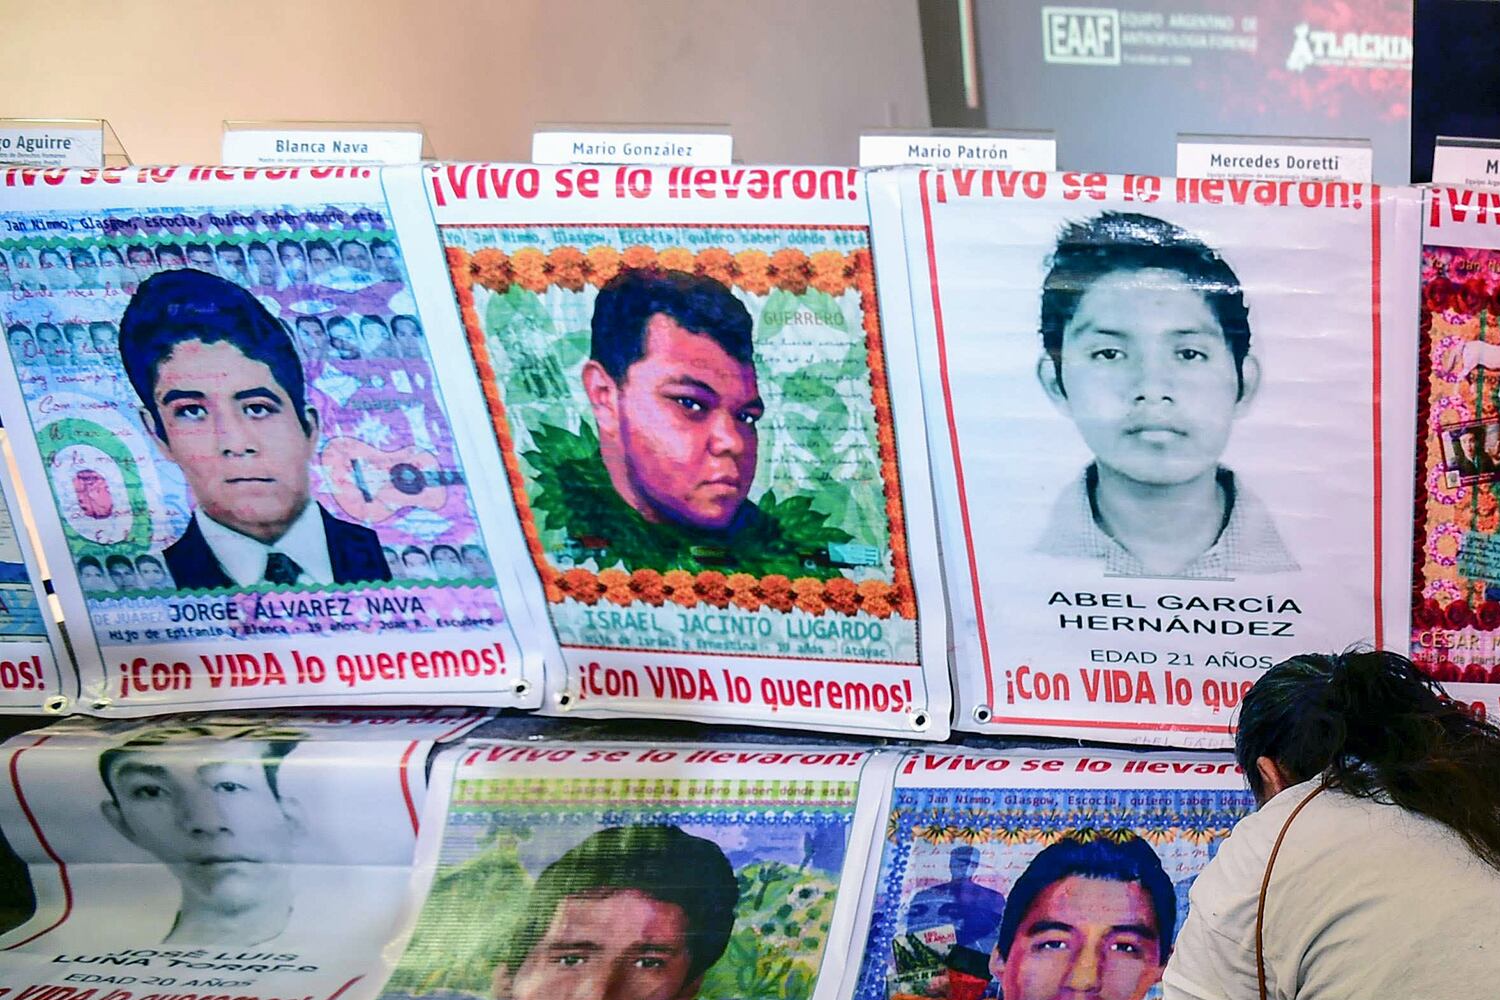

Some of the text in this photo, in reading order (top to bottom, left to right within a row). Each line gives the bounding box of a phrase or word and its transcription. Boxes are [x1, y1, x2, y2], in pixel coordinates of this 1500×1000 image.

[1051, 15, 1112, 57] EAAF
[16, 135, 71, 152] Aguirre
[276, 140, 368, 153] Blanca Nava
[573, 142, 692, 156] Mario González
[908, 144, 1008, 159] Mario Patrón
[1210, 154, 1339, 170] Mercedes Doretti
[555, 166, 857, 200] se lo llevaron!
[764, 312, 844, 326] GUERRERO
[169, 597, 425, 622] JORGE ÁLVAREZ NAVA
[1047, 592, 1302, 614] ABEL GARCÍA
[584, 610, 882, 642] ISRAEL JACINTO LUGARDO
[1059, 614, 1295, 638] HERNÁNDEZ
[1419, 630, 1480, 652] CÉSAR
[1090, 649, 1273, 671] EDAD 21 AÑOS
[120, 644, 506, 698] ¡Con VIDA lo queremos!
[579, 662, 912, 713] ¡Con VIDA lo queremos!
[1007, 666, 1193, 706] ¡Con VIDA lo
[683, 750, 864, 766] llevaron!
[904, 756, 1111, 774] ¡Vivo se lo
[928, 794, 950, 806] Jan
[1004, 795, 1058, 809] Glasgow,
[1068, 795, 1121, 807] Escocia,
[51, 955, 150, 967] LUNA
[214, 951, 300, 962] LUIS
[63, 973, 176, 987] EDAD 20
